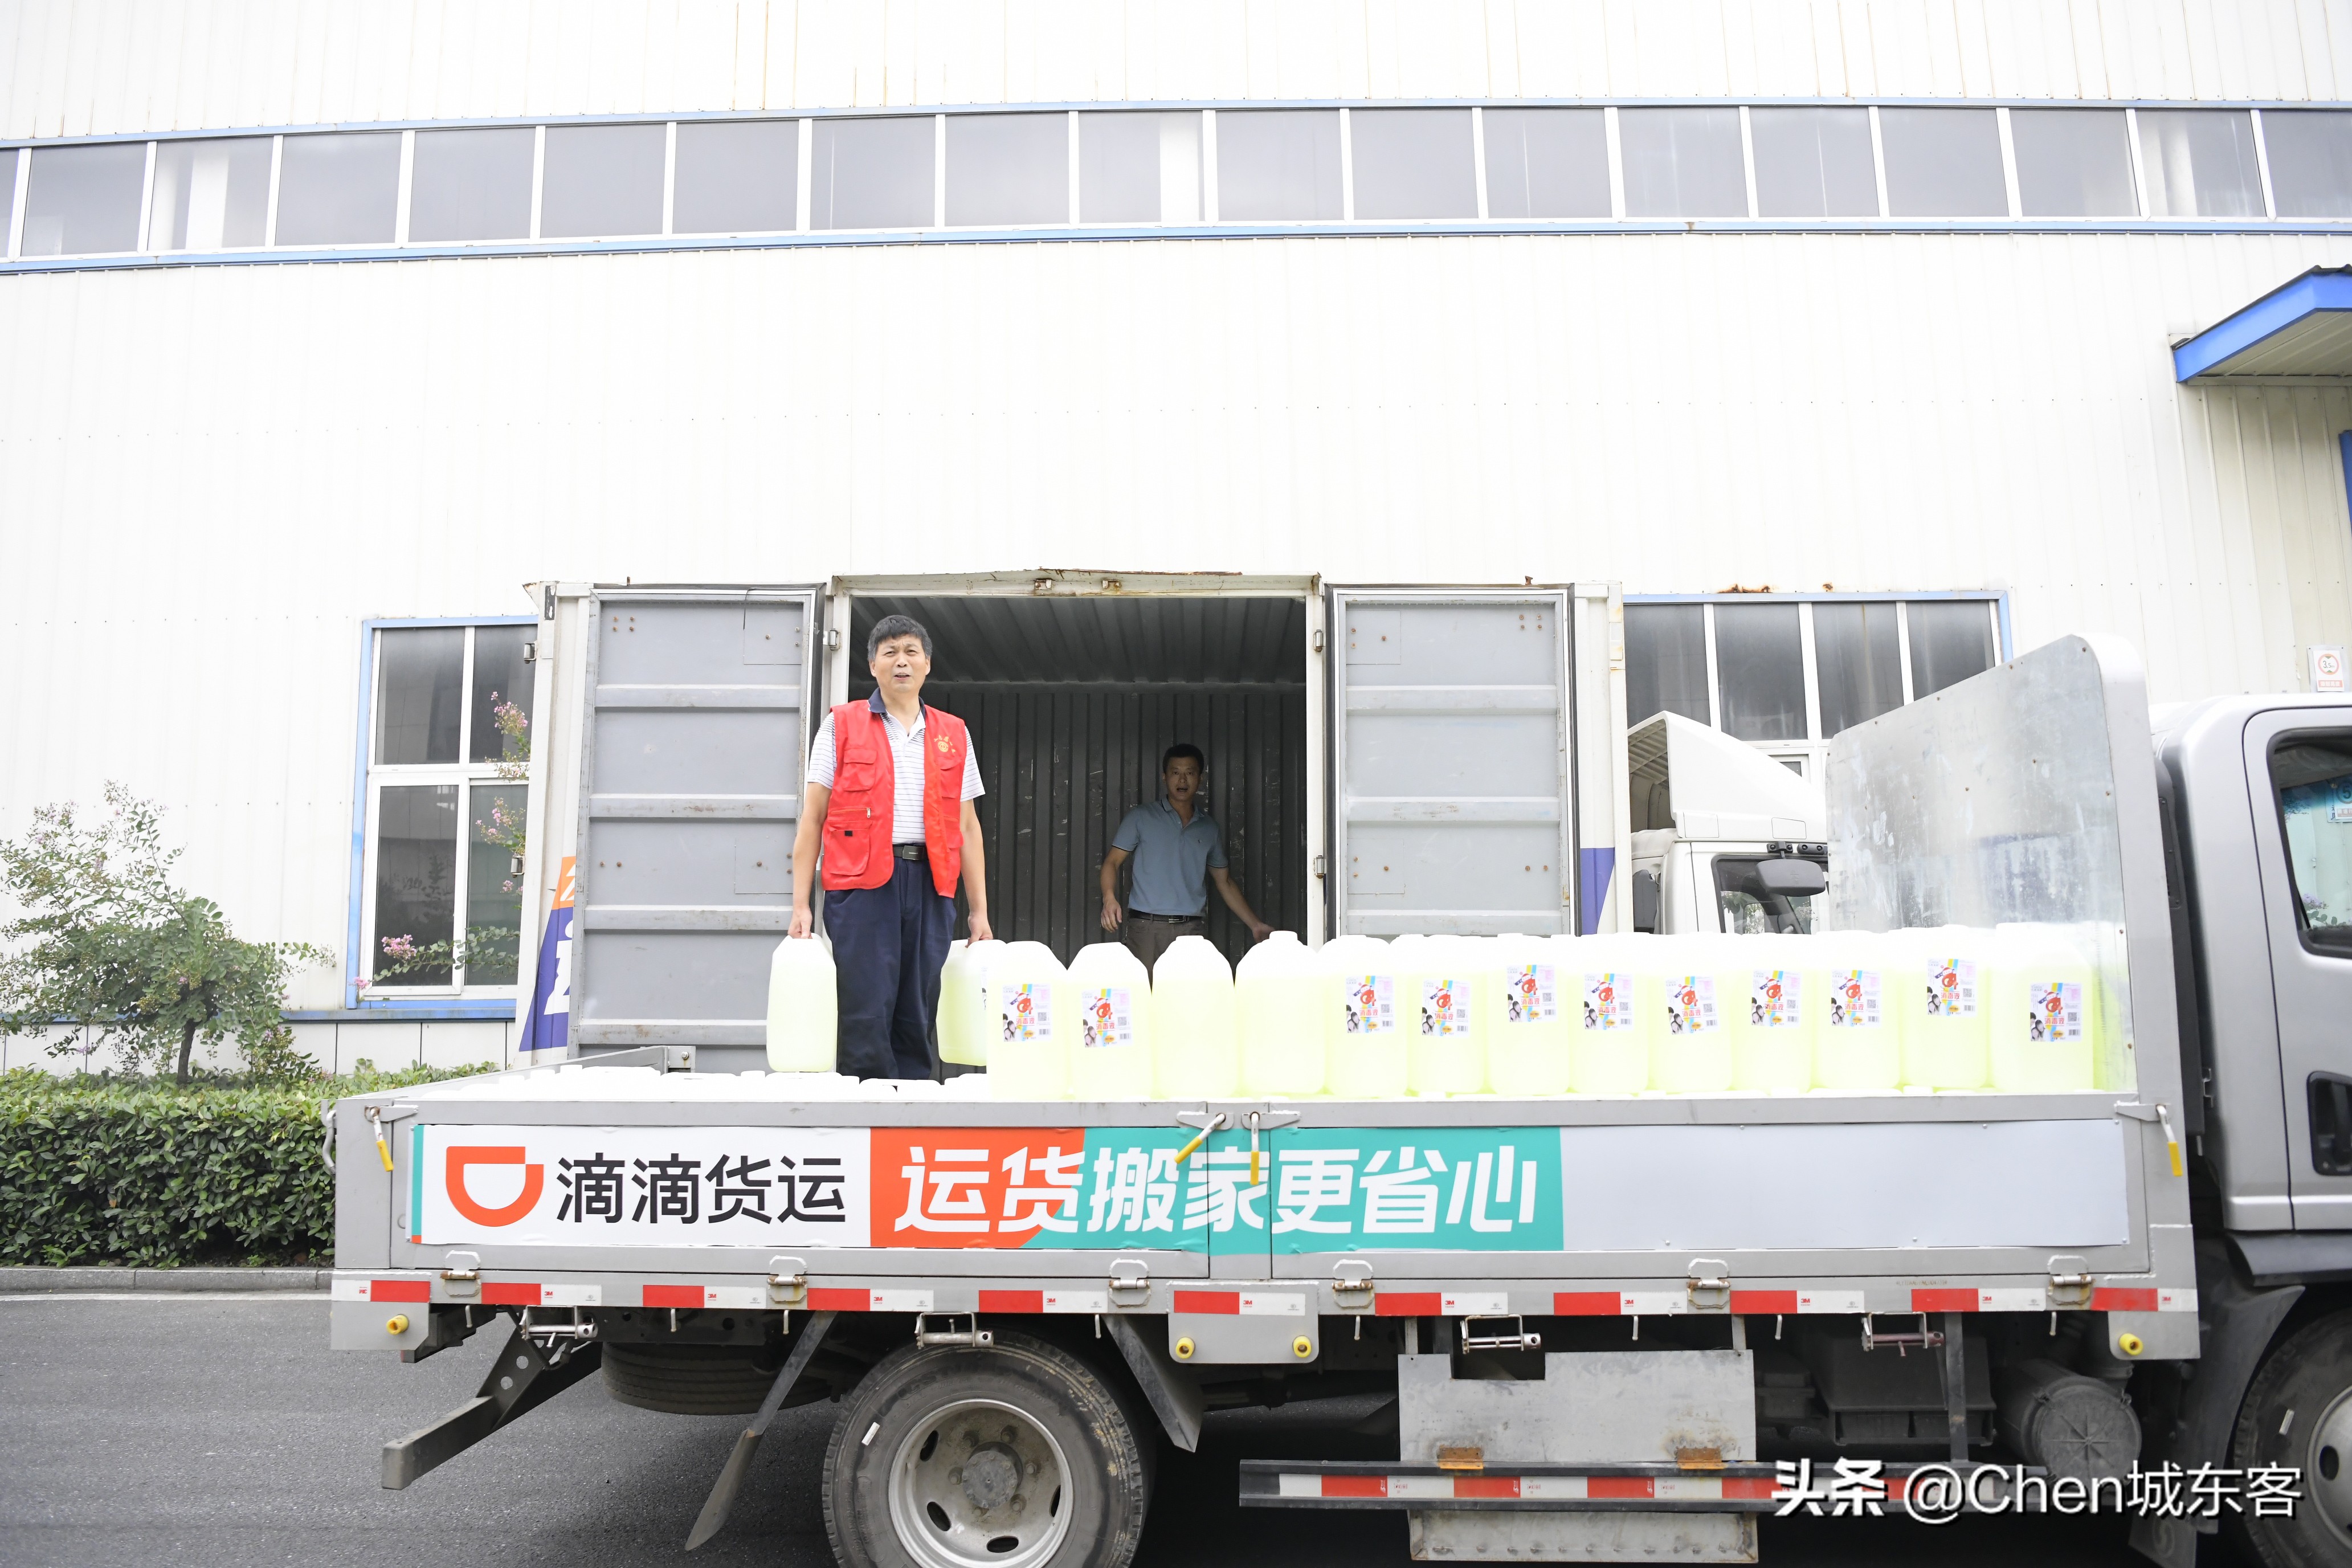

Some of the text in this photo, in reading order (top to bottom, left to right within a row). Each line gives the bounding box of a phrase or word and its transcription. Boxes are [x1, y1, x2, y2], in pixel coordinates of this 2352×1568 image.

[557, 1152, 846, 1224] 滴滴货运
[895, 1145, 1537, 1233] 运货搬家更省心
